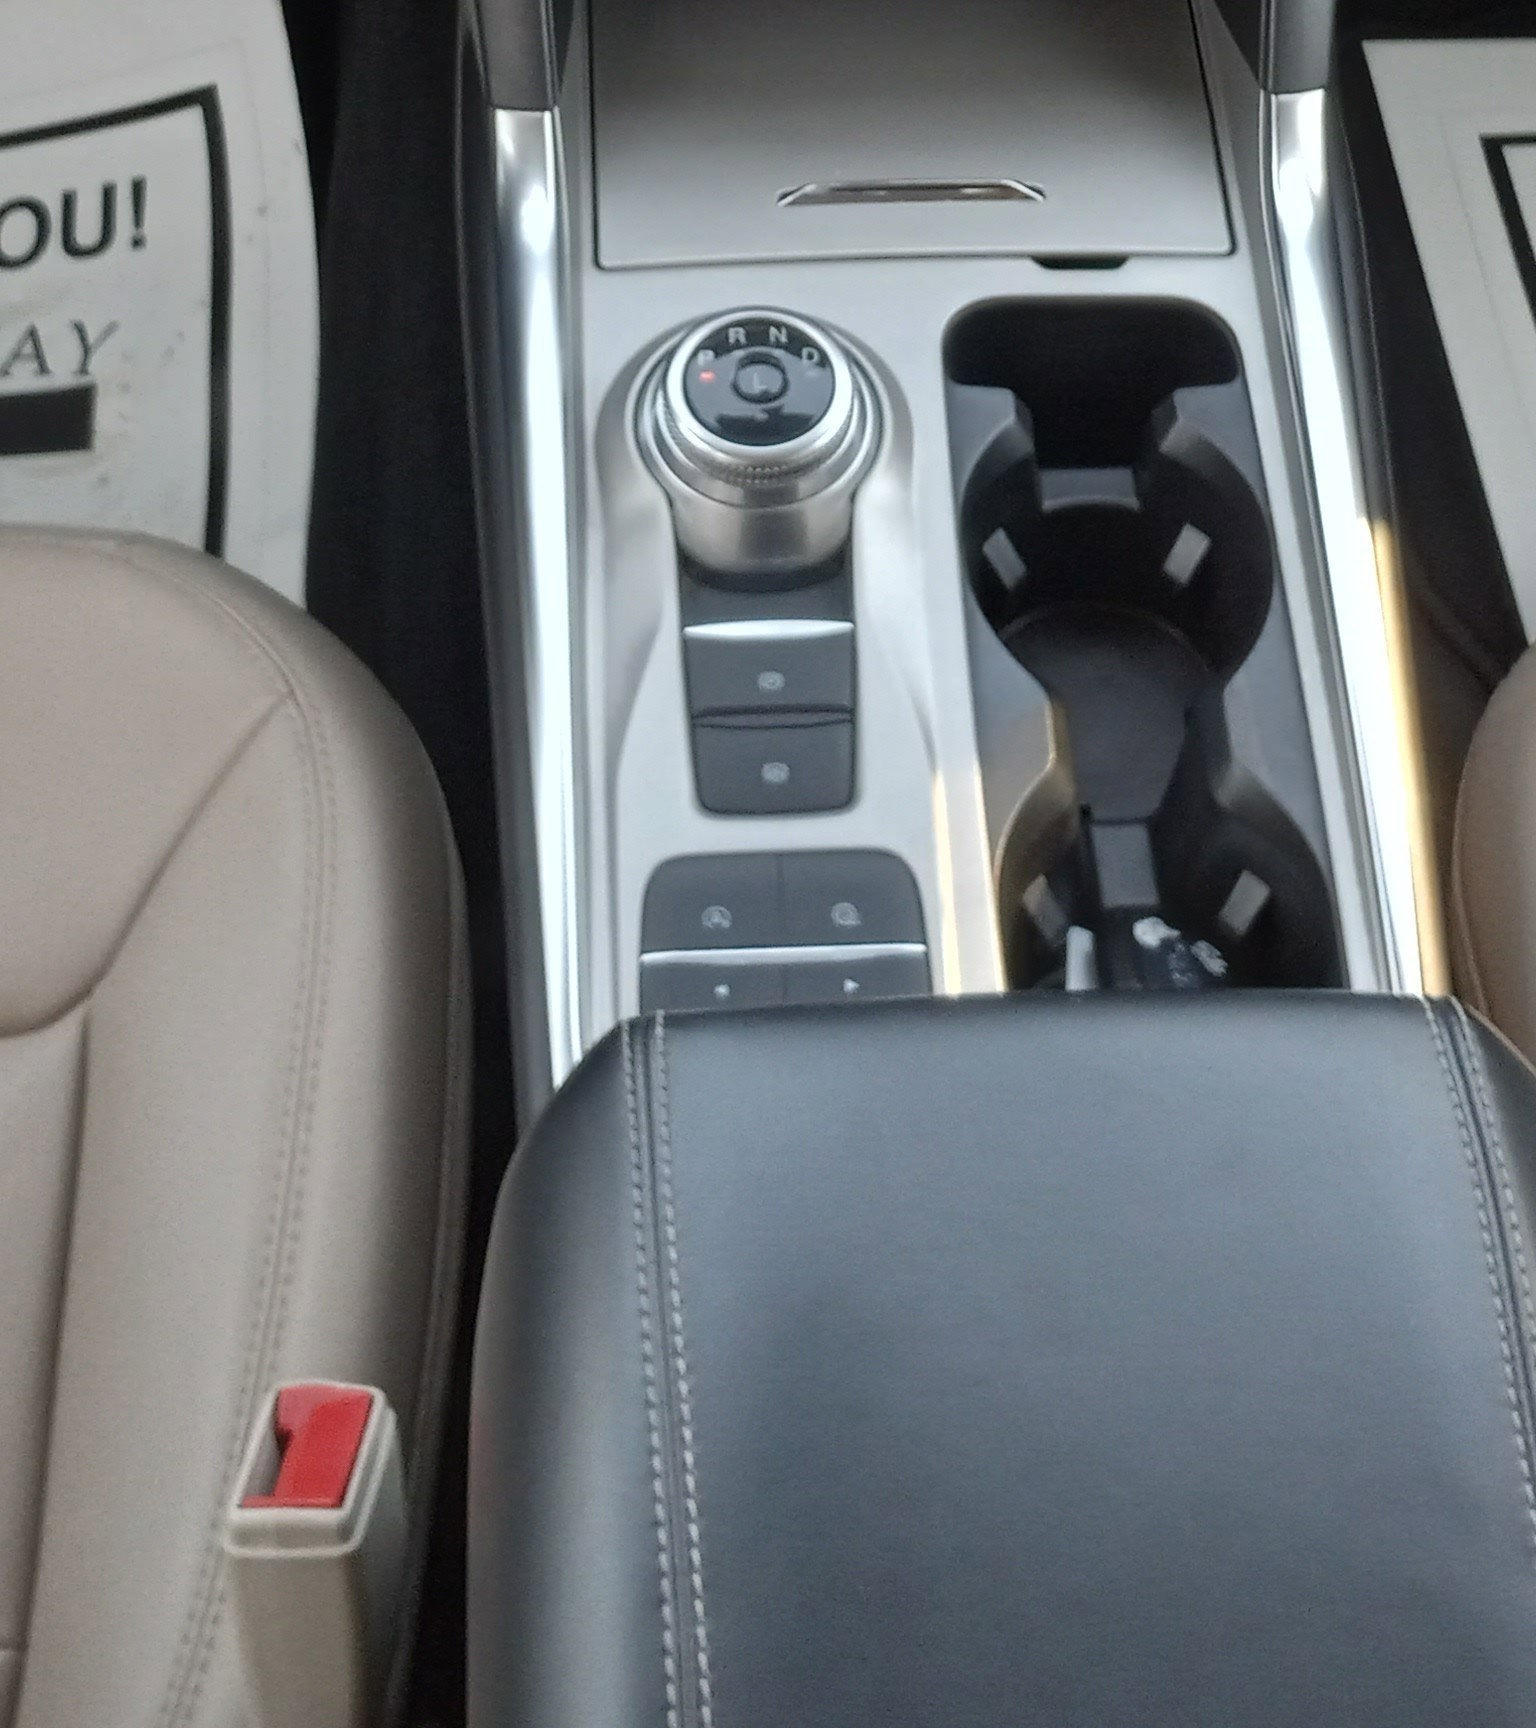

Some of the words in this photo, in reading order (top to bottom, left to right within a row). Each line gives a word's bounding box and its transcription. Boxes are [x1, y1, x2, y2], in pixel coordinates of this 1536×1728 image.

[727, 327, 747, 346] R
[768, 325, 789, 344] N
[802, 347, 819, 365] D
